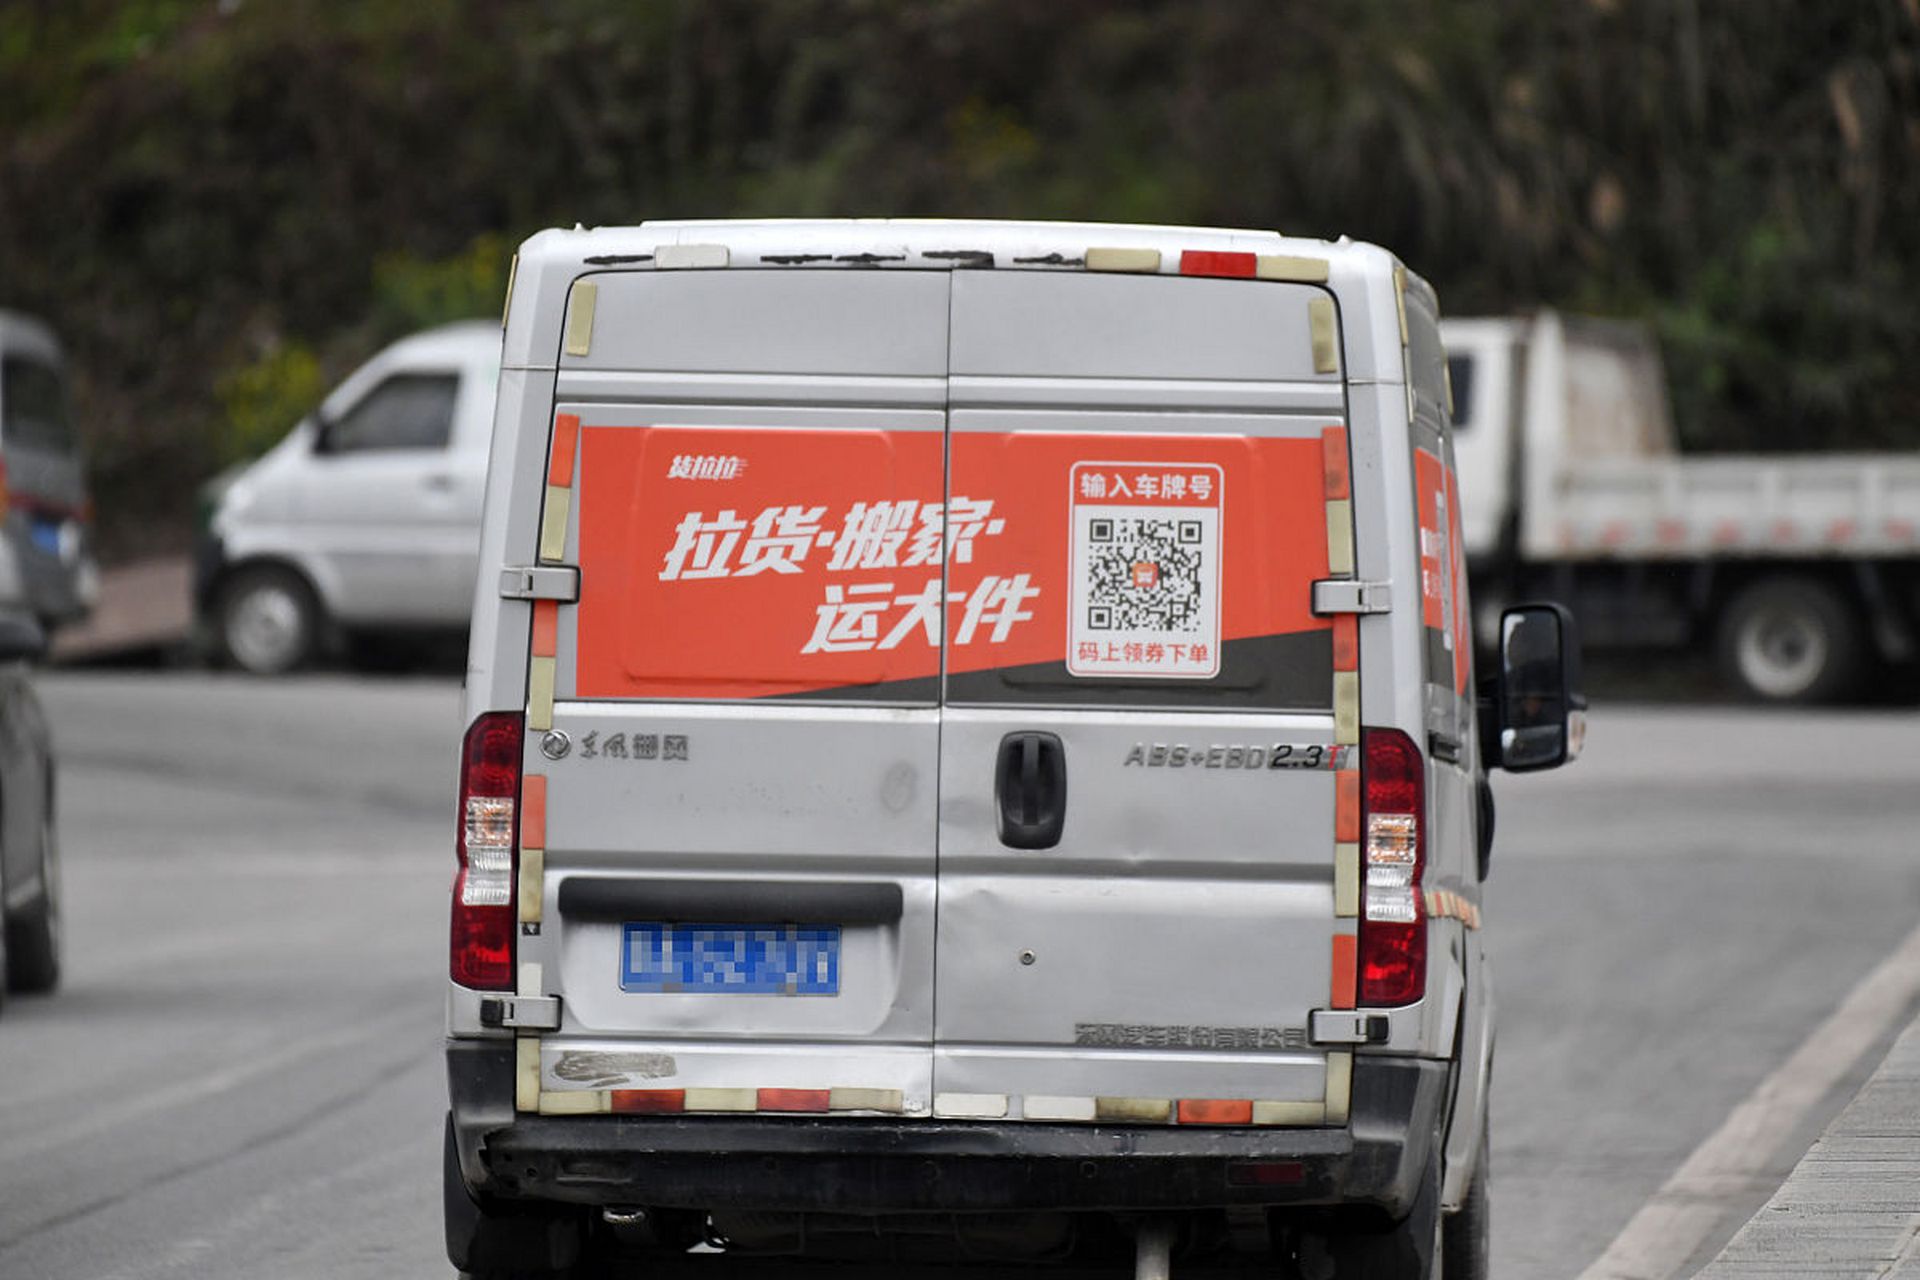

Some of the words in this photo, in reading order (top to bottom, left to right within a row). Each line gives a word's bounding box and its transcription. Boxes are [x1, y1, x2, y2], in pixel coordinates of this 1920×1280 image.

[1080, 473, 1213, 500] 输入车牌号
[800, 573, 1041, 654] 运大件
[1078, 641, 1210, 665] 码上领券下单
[1123, 743, 1266, 769] ABS+EBD
[1271, 744, 1345, 769] 2.3T
